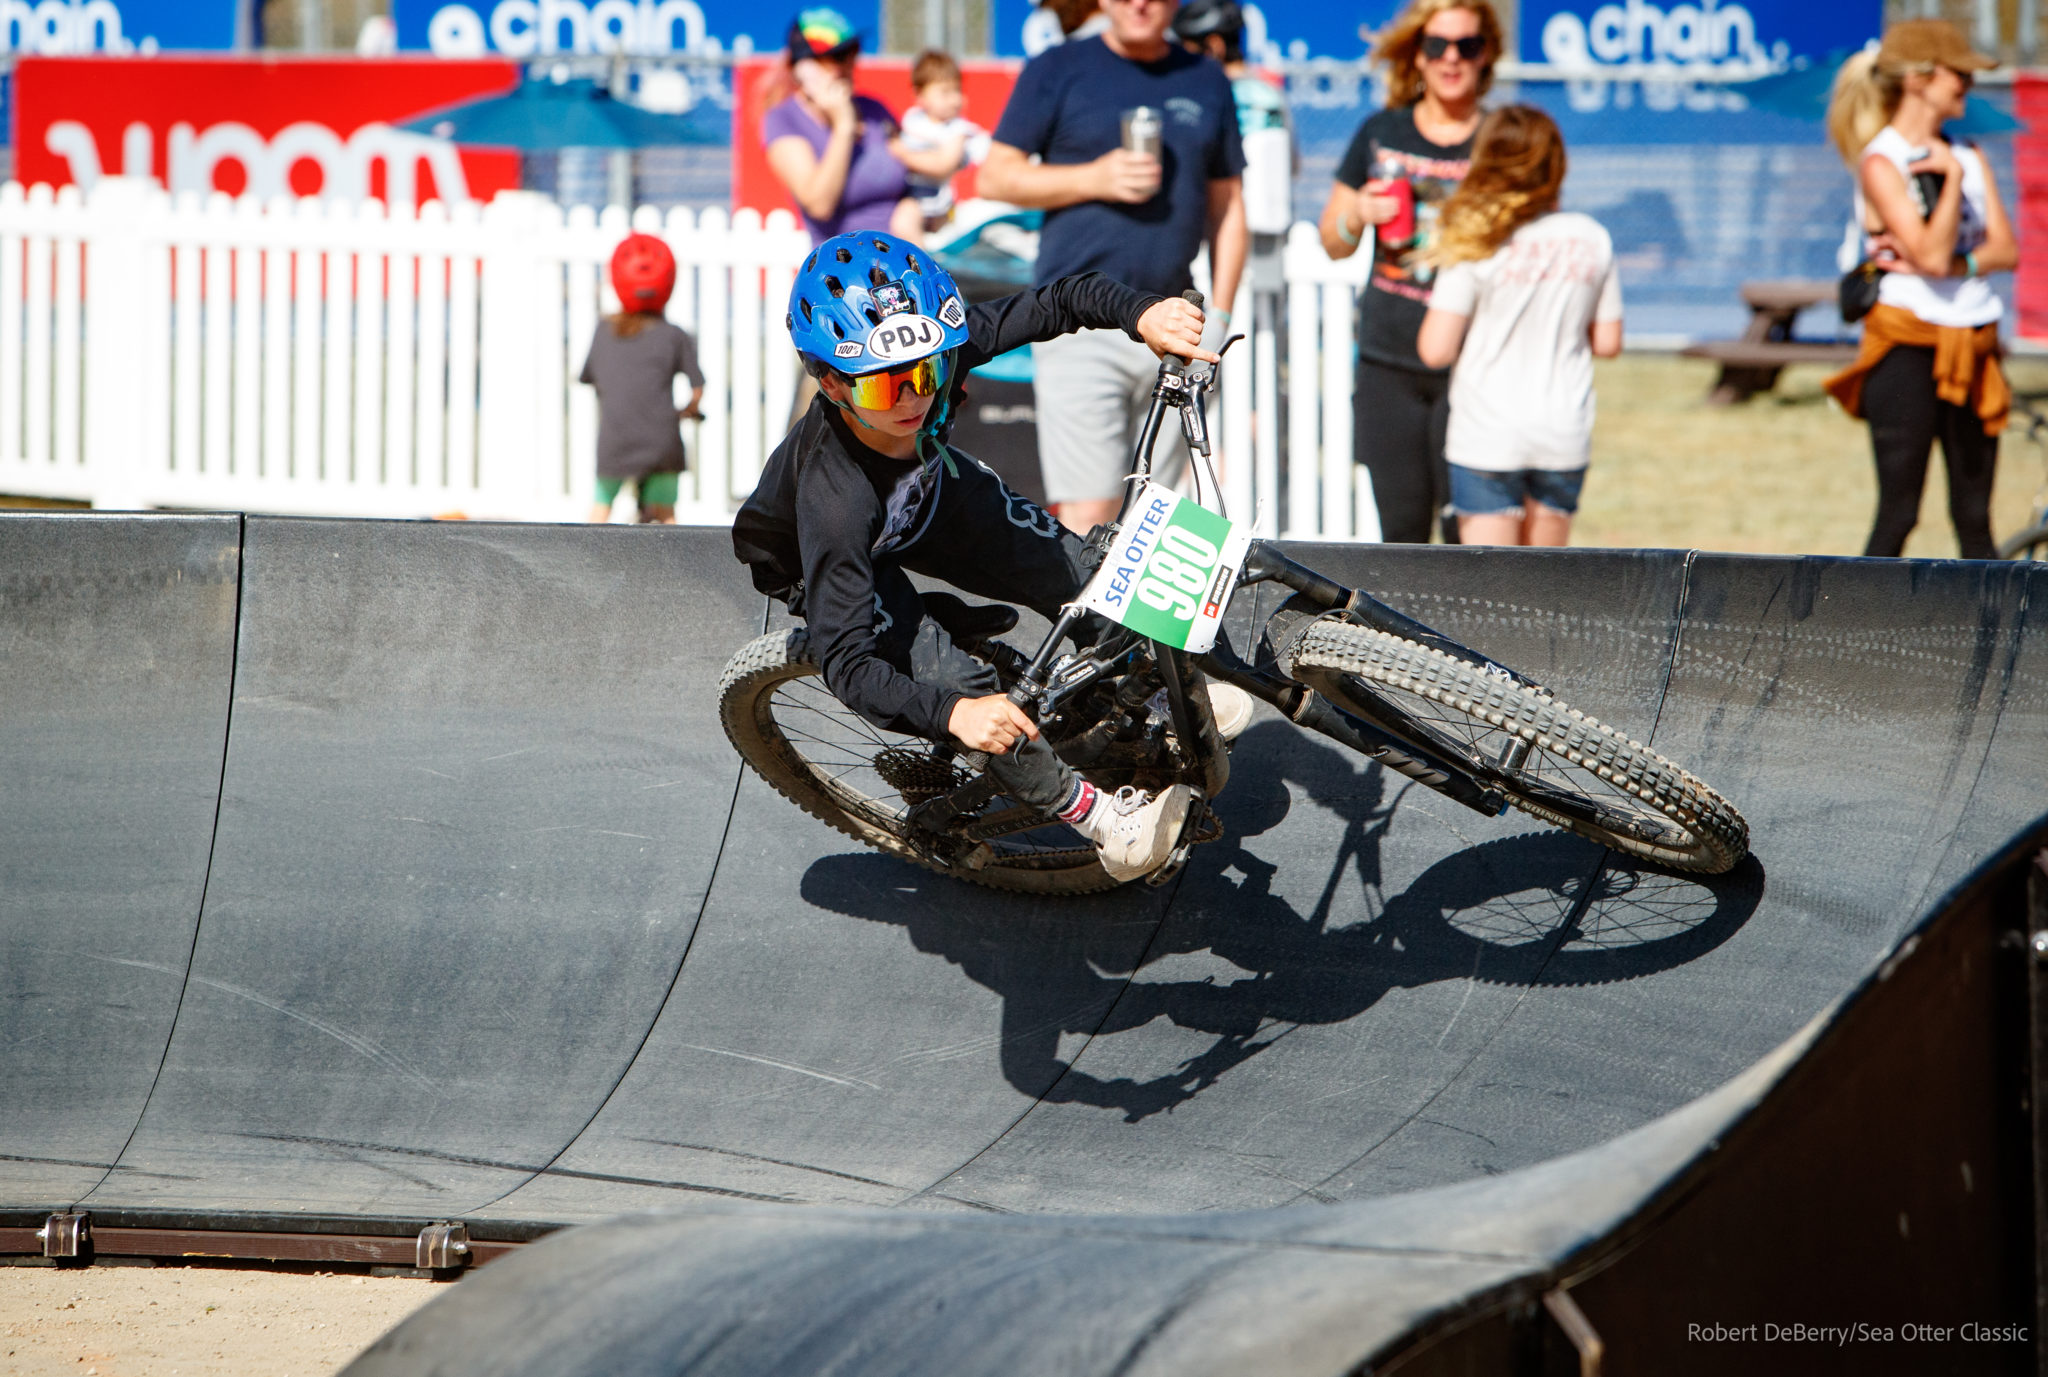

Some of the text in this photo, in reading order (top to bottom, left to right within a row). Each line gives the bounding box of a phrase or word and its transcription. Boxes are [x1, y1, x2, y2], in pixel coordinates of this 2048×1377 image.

[879, 322, 933, 353] PDJ
[1105, 498, 1170, 607] SEA OTTER
[1137, 525, 1218, 621] 980
